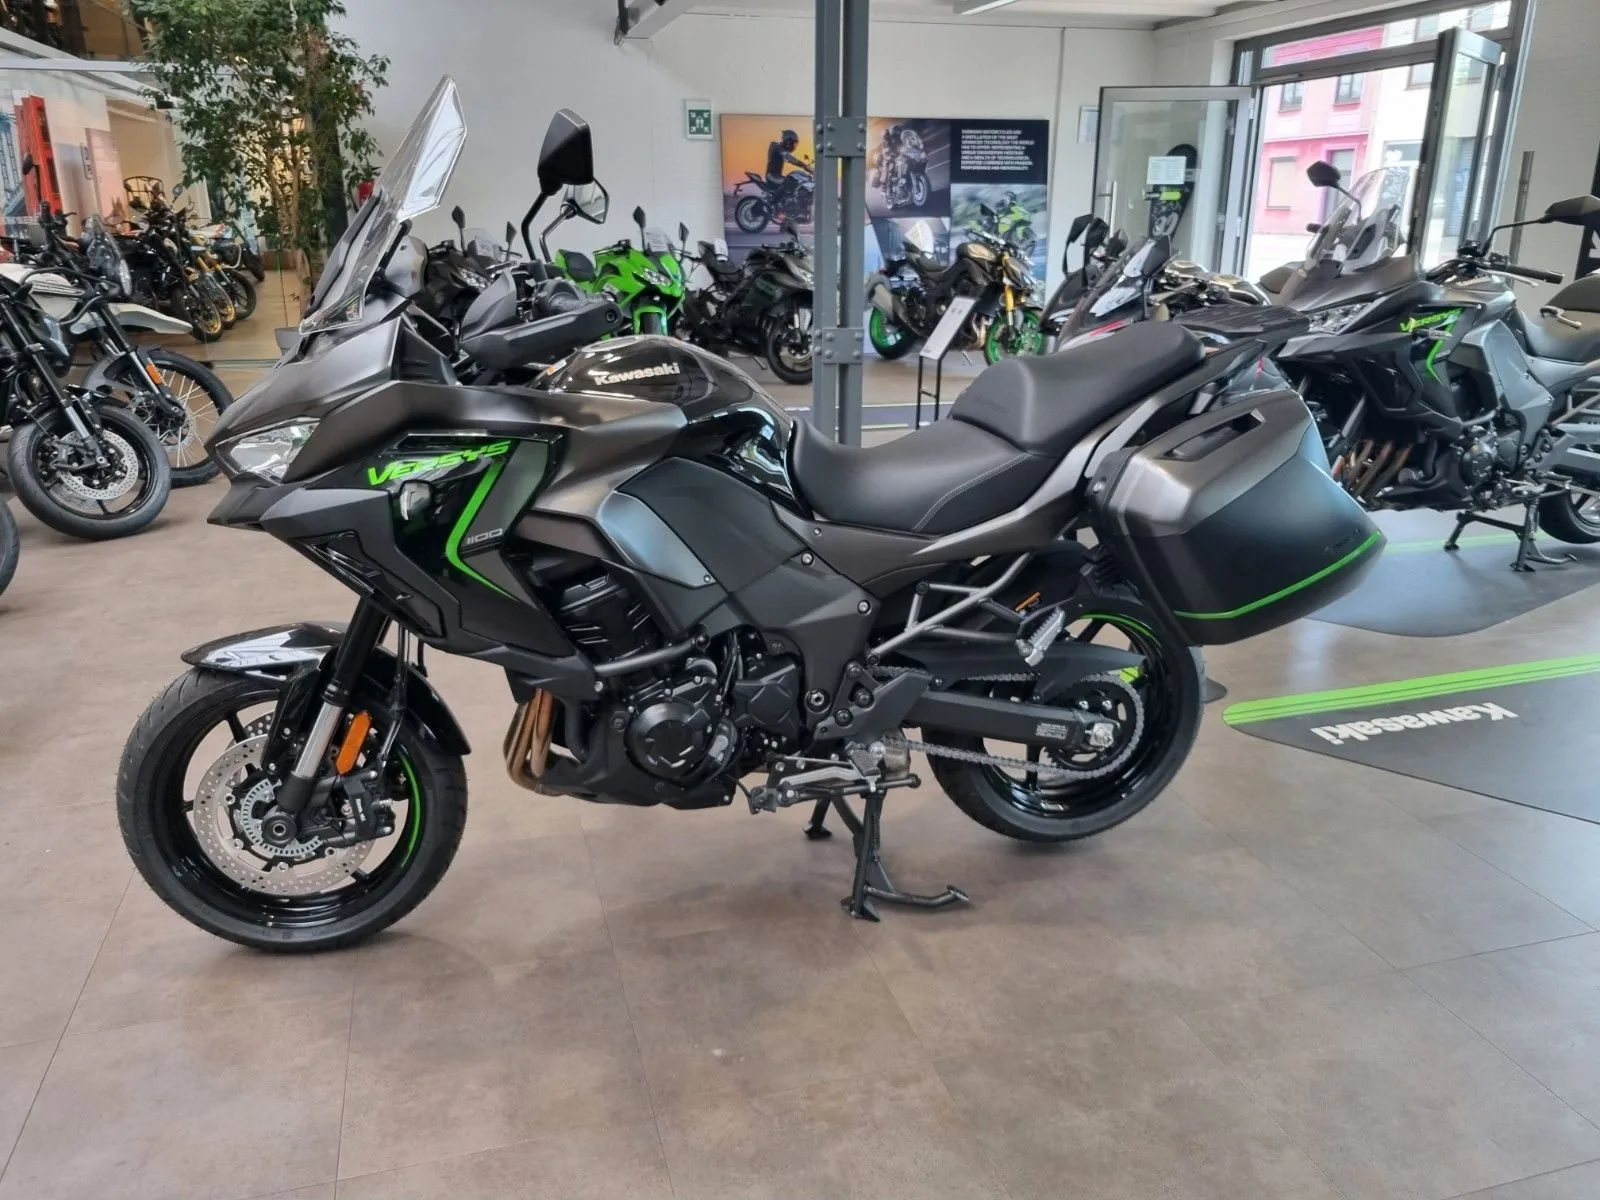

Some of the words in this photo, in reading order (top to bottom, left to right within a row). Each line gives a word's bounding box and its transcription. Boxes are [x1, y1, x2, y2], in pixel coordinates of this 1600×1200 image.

[594, 362, 680, 386] Kawasaki
[367, 440, 512, 486] VERSYS
[467, 528, 503, 545] 1100
[1310, 702, 1519, 745] Kawasaki
